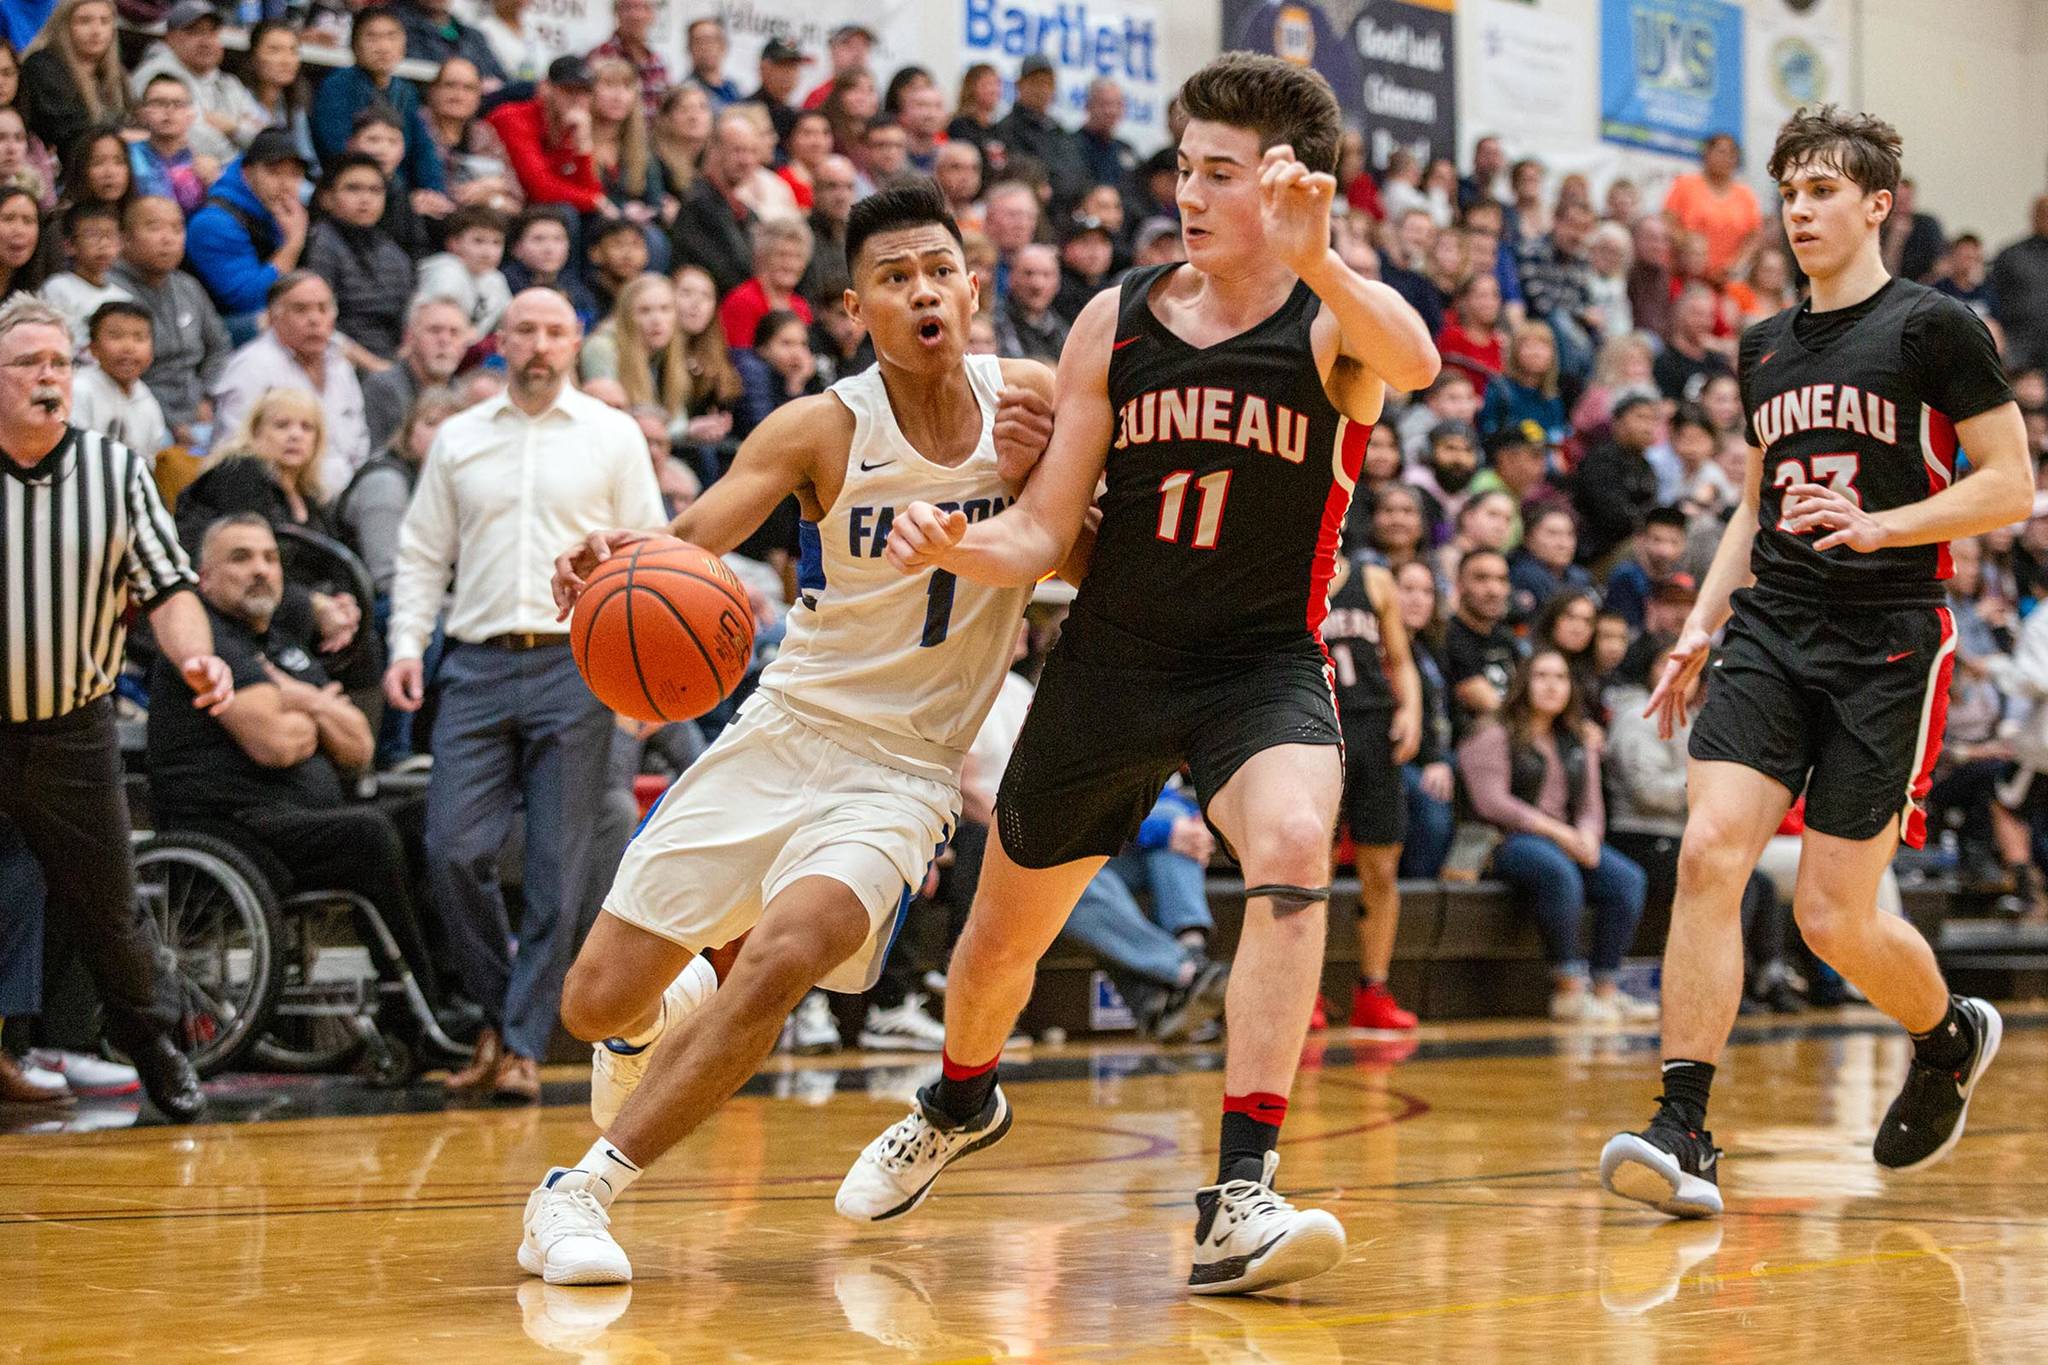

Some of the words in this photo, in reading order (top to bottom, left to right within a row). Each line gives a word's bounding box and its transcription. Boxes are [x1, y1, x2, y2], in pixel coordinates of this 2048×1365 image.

[966, 0, 1158, 81] Bartlett
[1154, 468, 1234, 550] 11
[918, 566, 957, 648] 1
